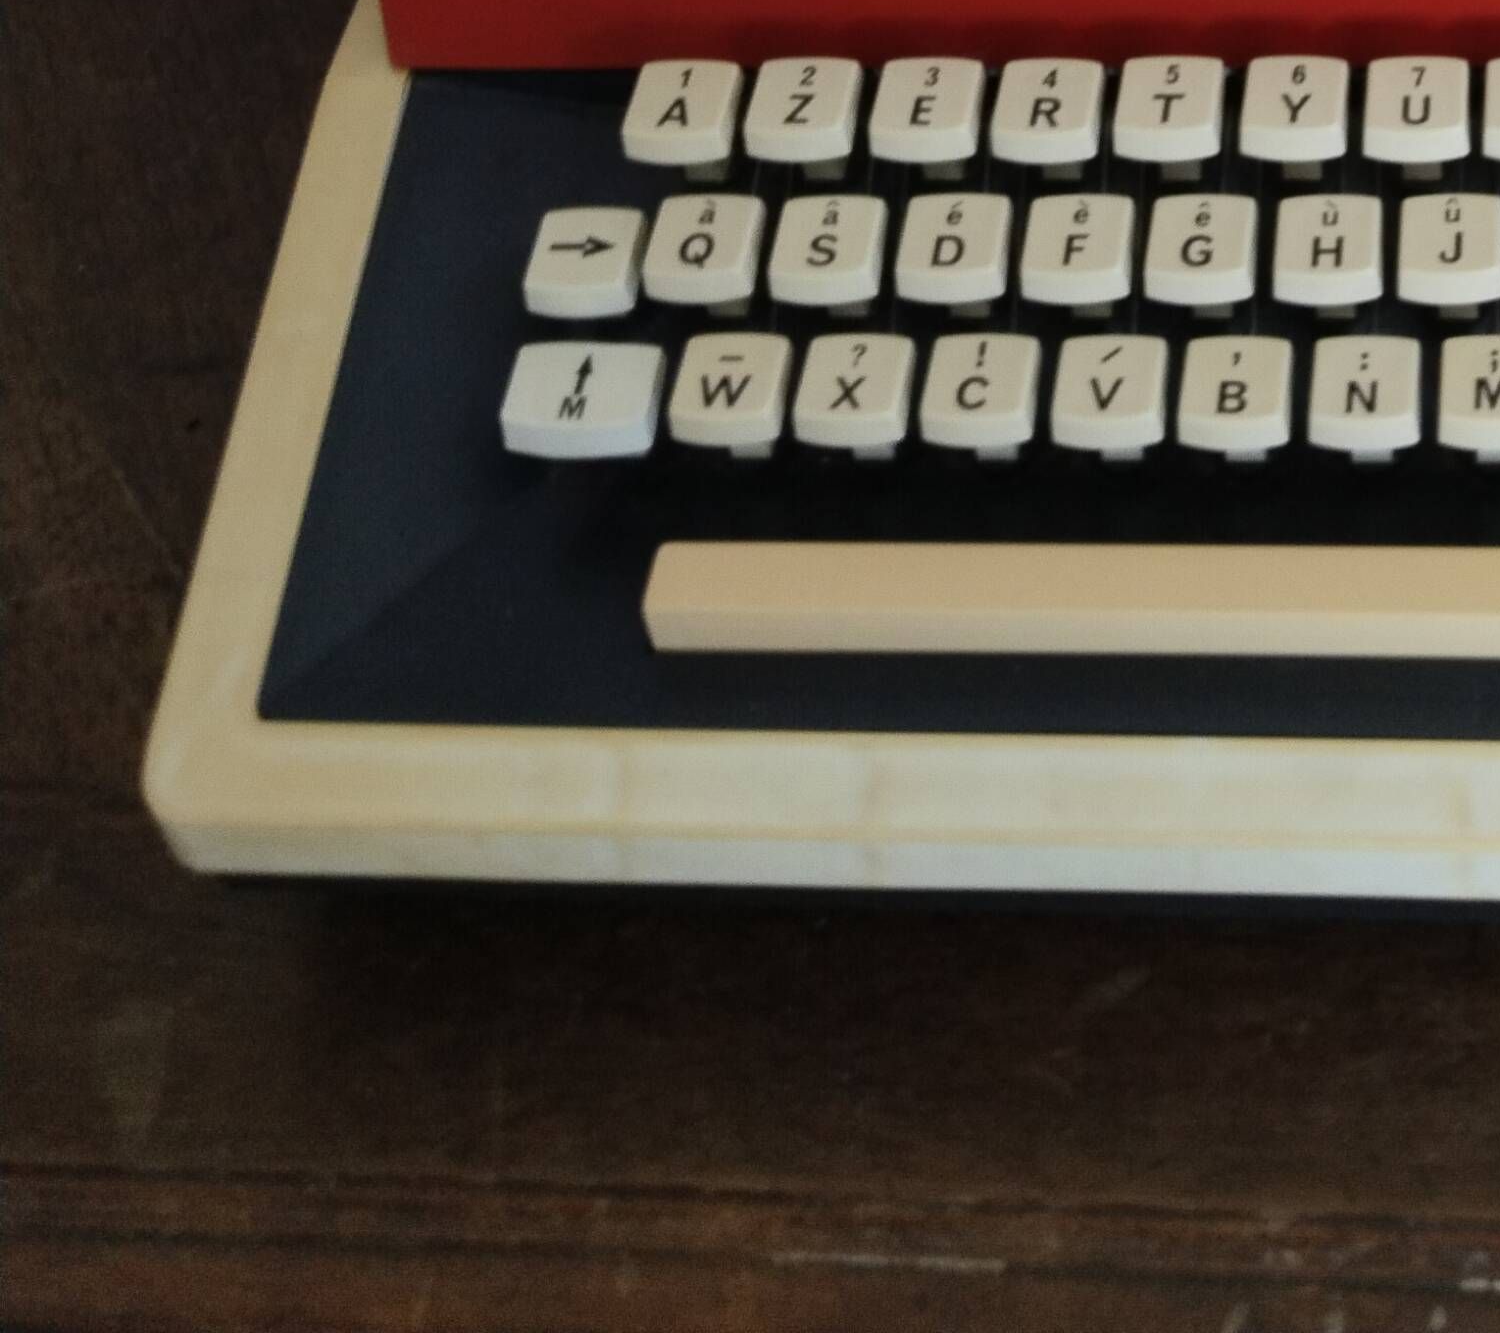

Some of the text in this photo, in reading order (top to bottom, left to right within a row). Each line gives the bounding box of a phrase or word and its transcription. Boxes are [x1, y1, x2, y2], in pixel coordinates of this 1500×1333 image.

[681, 68, 693, 88] 1
[799, 65, 817, 86] 2
[924, 66, 941, 87] 3
[1042, 69, 1058, 89] 4
[1166, 64, 1180, 85] 5
[1291, 65, 1306, 84] 6
[1412, 66, 1426, 87] 7
[657, 97, 688, 127] A
[783, 93, 814, 124] Z
[909, 96, 935, 125] E
[1029, 97, 1061, 127] R
[1153, 93, 1184, 123] T
[1282, 94, 1311, 123] Y
[1401, 95, 1431, 126] U
[678, 232, 715, 268] Q
[807, 234, 837, 267] S
[931, 235, 965, 267] D
[1062, 234, 1088, 266] F
[1180, 234, 1213, 267] G
[1311, 236, 1344, 268] H
[1439, 231, 1463, 264] J
[853, 343, 868, 366] ?
[975, 341, 987, 368] !
[559, 393, 587, 419] M
[701, 375, 751, 407] W
[831, 377, 865, 409] X
[955, 376, 989, 410] C
[1090, 378, 1123, 411] V
[1216, 380, 1247, 414] B
[1345, 381, 1378, 413] N
